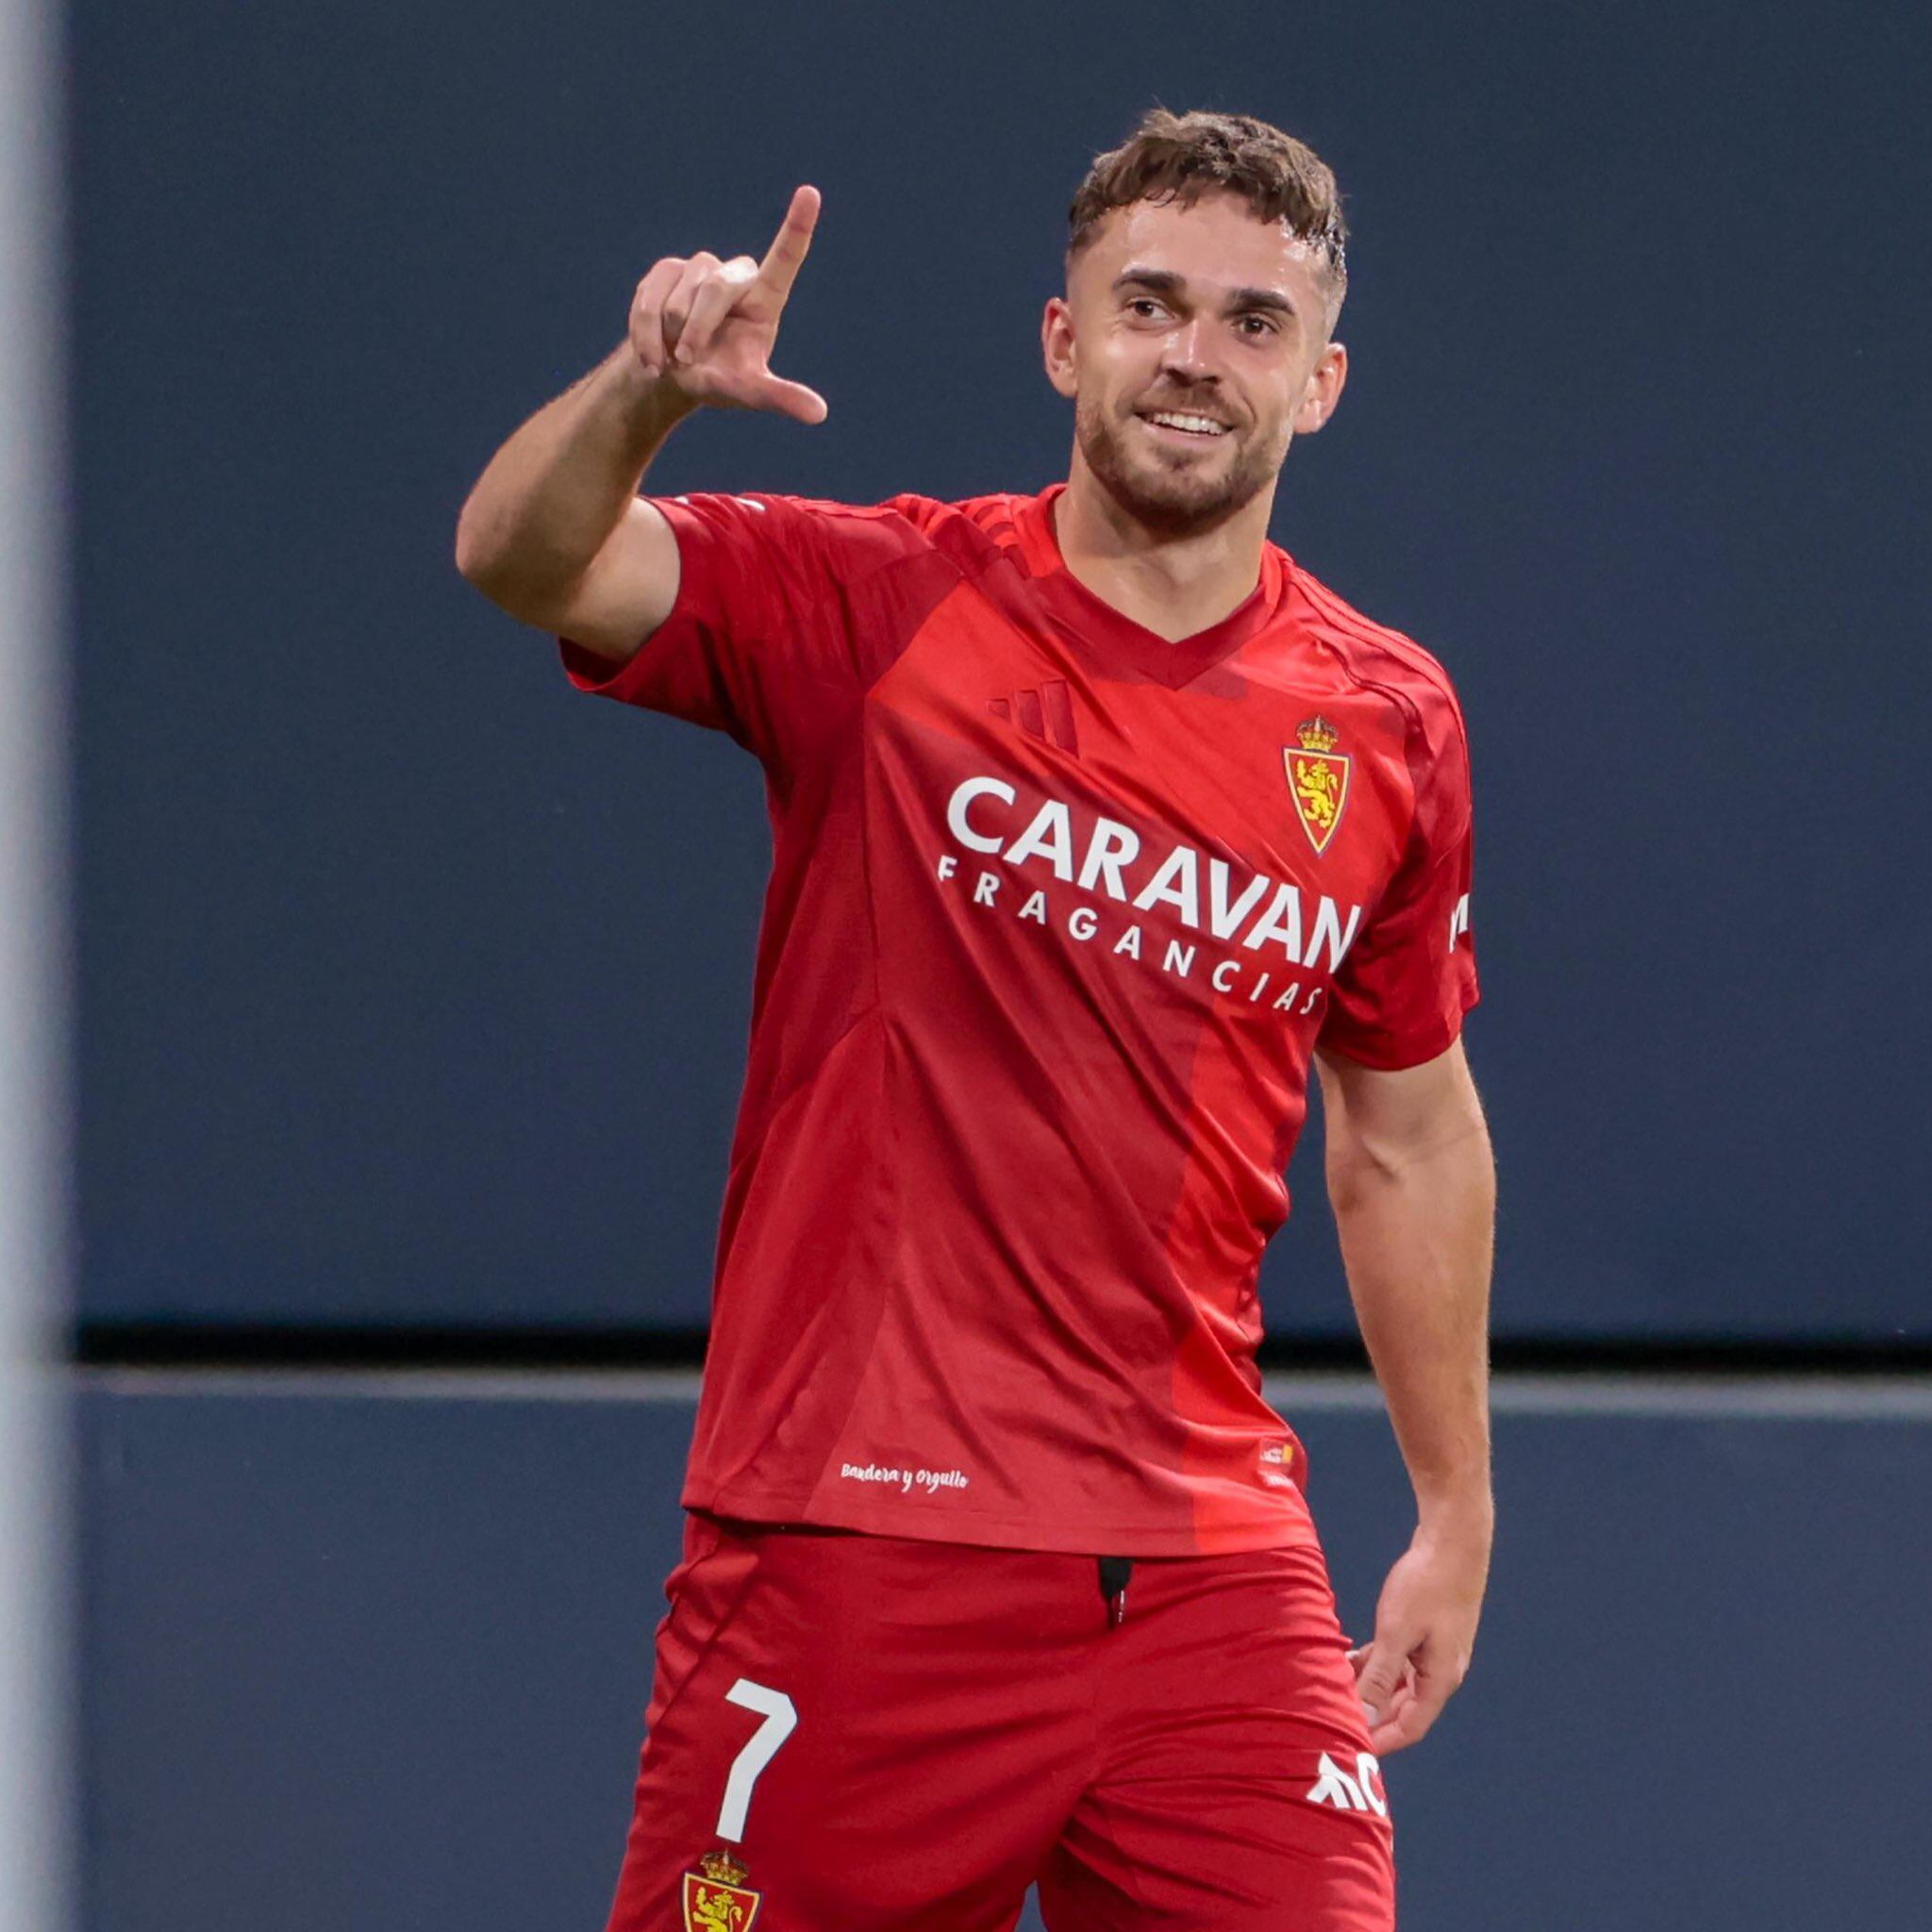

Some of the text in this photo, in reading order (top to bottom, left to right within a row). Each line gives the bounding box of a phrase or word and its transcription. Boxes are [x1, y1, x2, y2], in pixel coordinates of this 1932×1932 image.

[937, 855, 1322, 1014] FRAGANCIAS
[947, 776, 1361, 974] CARAVAN
[841, 1463, 969, 1493] Bandera y Orgullo
[716, 1678, 797, 1843] 7
